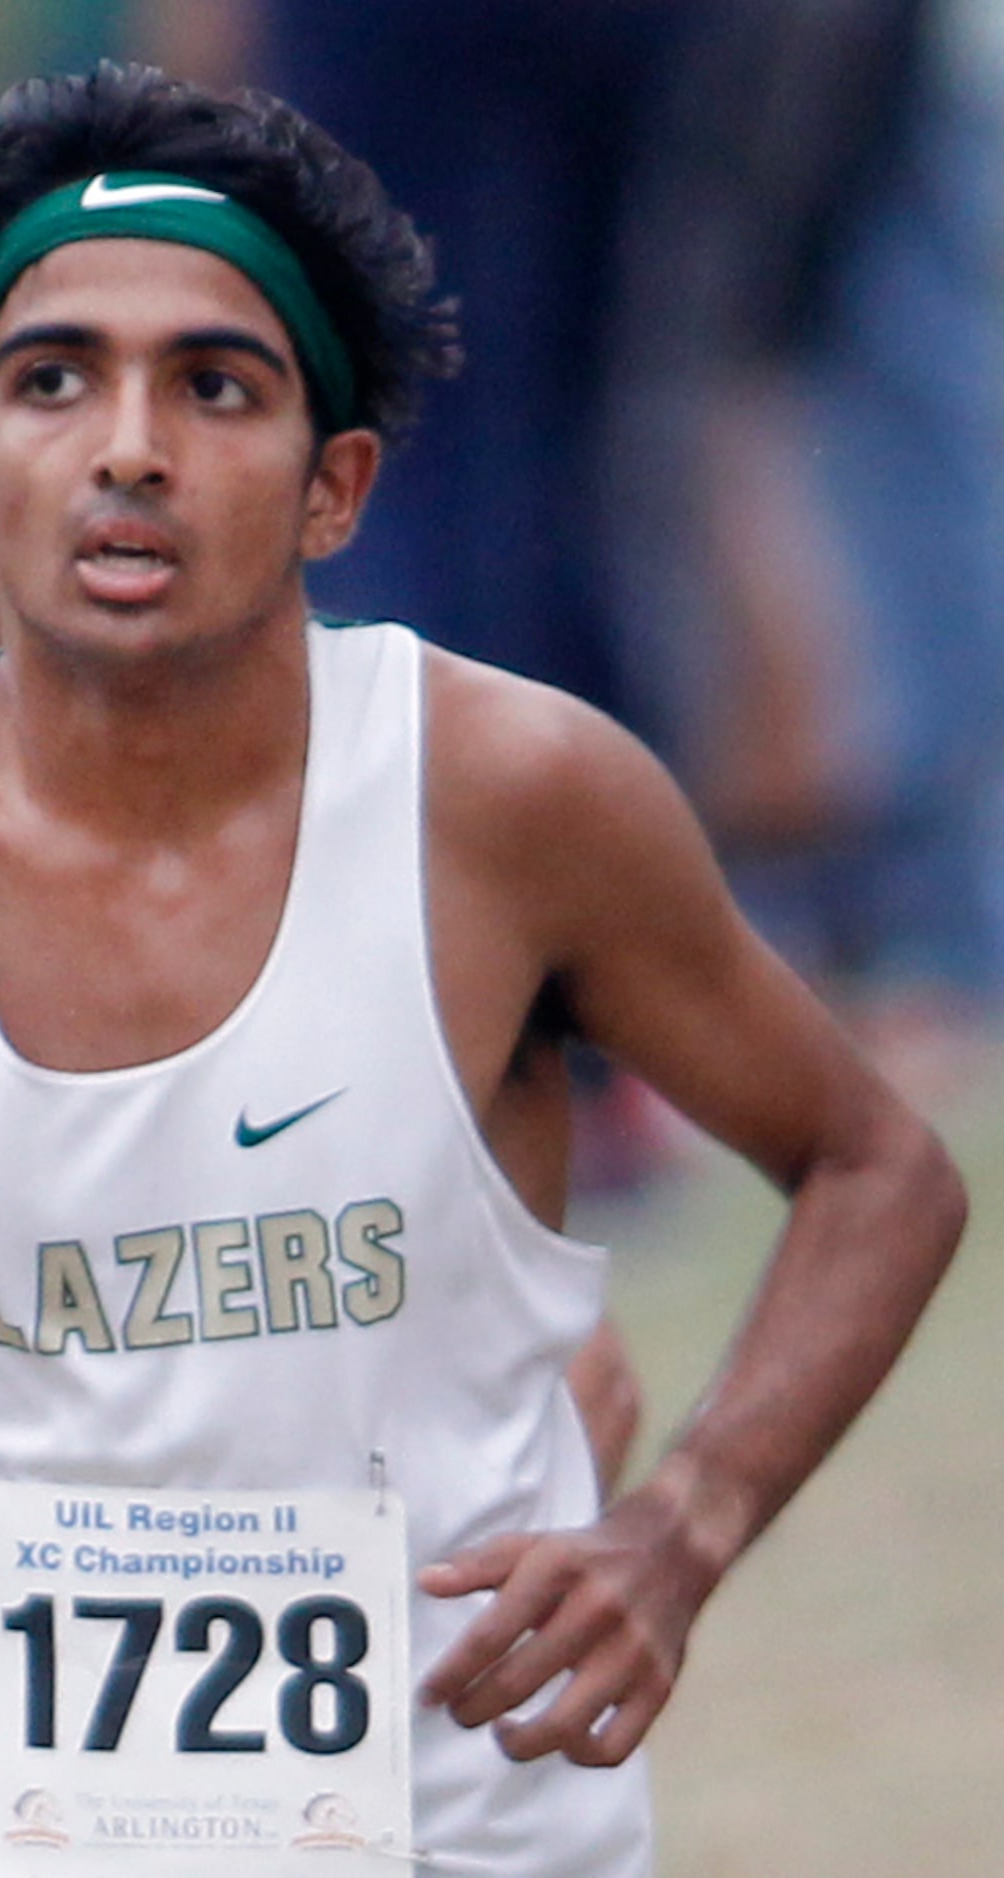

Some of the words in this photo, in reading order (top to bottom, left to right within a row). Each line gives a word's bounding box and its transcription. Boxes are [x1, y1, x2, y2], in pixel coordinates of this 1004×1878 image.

[55, 1501, 113, 1528] UIL
[127, 1504, 259, 1536] Region
[274, 1506, 297, 1532] II
[15, 1541, 62, 1570] XC
[73, 1545, 345, 1580] Championship
[1, 1593, 370, 1755] 1728
[94, 1815, 262, 1839] ARLINGTON
